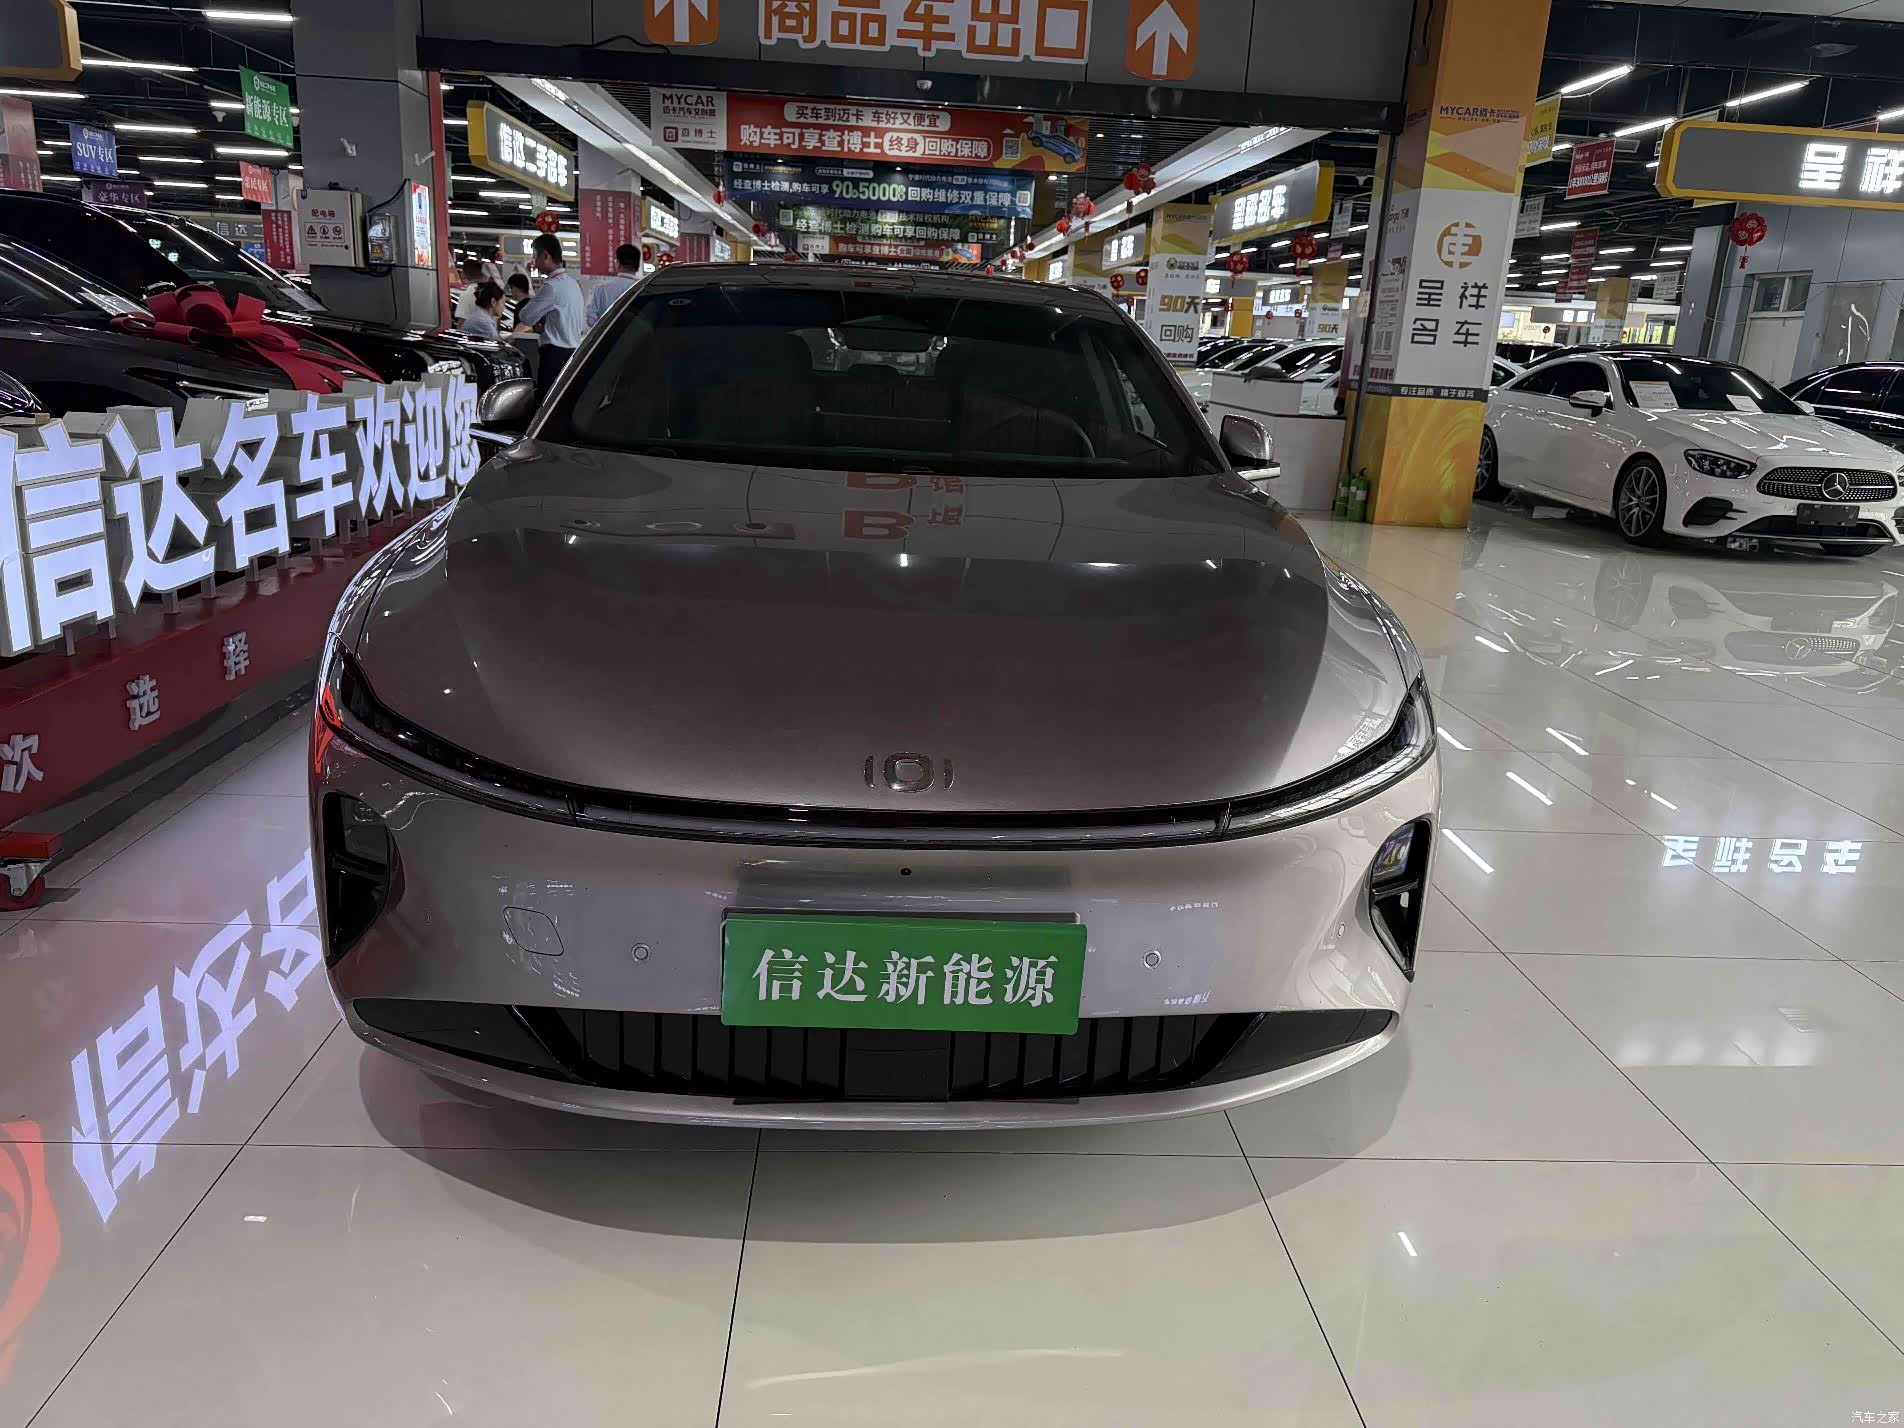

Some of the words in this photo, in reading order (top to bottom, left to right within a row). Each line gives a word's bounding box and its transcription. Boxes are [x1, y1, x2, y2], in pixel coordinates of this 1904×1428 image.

[760, 0, 1091, 62] 商品车出口
[245, 91, 289, 127] 新能源专区
[662, 93, 715, 108] MYCAR
[795, 104, 864, 123] 买车到迈卡
[871, 109, 940, 128] 车好又便宜
[76, 141, 114, 163] SUV专区
[908, 186, 1011, 207] 回购维修双重保障
[311, 209, 336, 218] 配电箱
[1159, 295, 1200, 314] 90天
[1416, 278, 1489, 310] 呈祥
[1160, 323, 1194, 343] 回购
[1410, 317, 1483, 347] 名车
[0, 375, 481, 655] 信达名车欢迎您
[752, 948, 1058, 1008] 信达新能源
